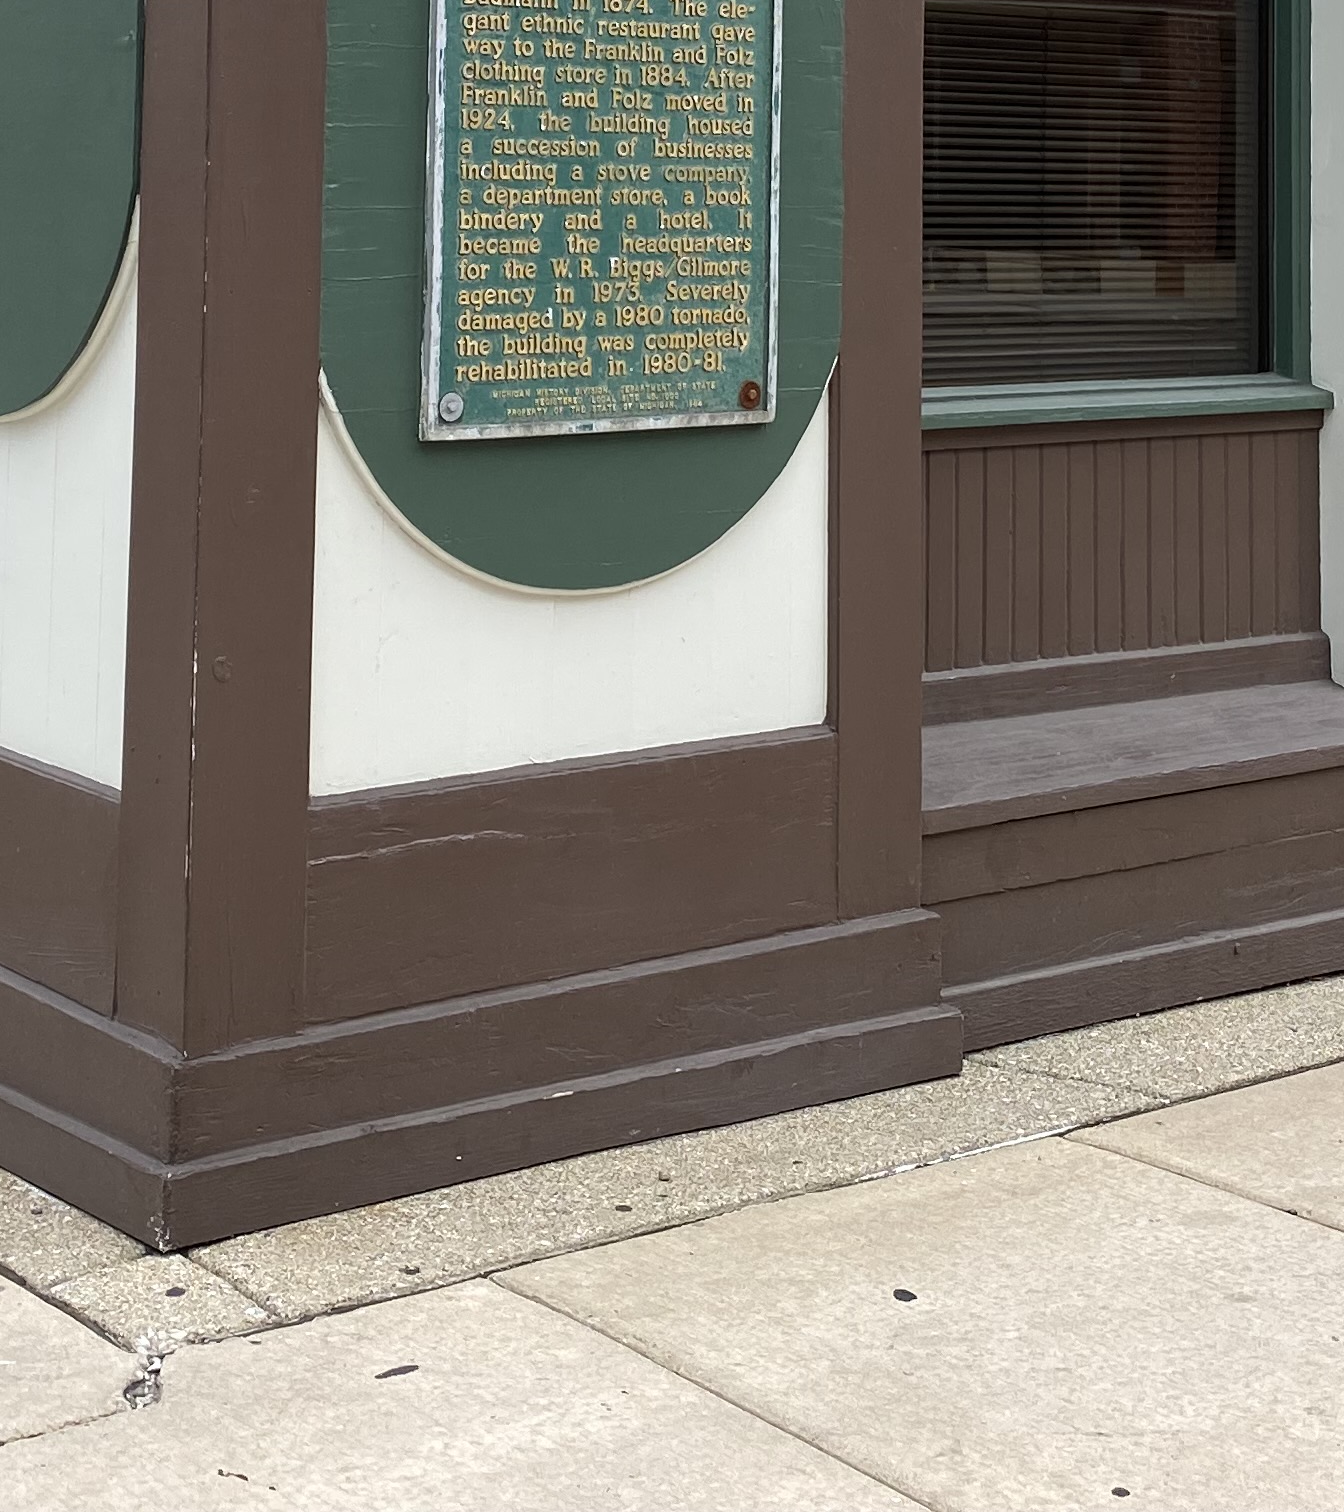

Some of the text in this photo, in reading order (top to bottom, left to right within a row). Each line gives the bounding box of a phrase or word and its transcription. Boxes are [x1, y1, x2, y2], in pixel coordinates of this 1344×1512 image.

[718, 0, 756, 19] ele-
[462, 11, 755, 45] gant ethnic restaurant gave
[463, 36, 755, 67] way to the Franklin and Folz
[461, 60, 755, 89] clothing store in 1884. After
[461, 83, 755, 113] Franklin and Folz moved in
[461, 108, 754, 140] 1924, the building housed
[460, 135, 754, 159] a succession of businesses
[460, 160, 753, 187] including a stove company,
[460, 184, 753, 209] a department store, a book
[459, 208, 753, 233] bindery and a hotel. It
[459, 233, 753, 257] became the headquarters
[459, 259, 491, 281] for
[503, 259, 537, 280] the
[609, 256, 752, 283] Biggs/Gilmore
[458, 280, 751, 312] agency in 1973. Severely
[457, 303, 751, 335] damaged by a 1980 tornado,
[457, 328, 750, 359] the building was completely
[456, 350, 727, 384] rehabilitated in 1980-81.
